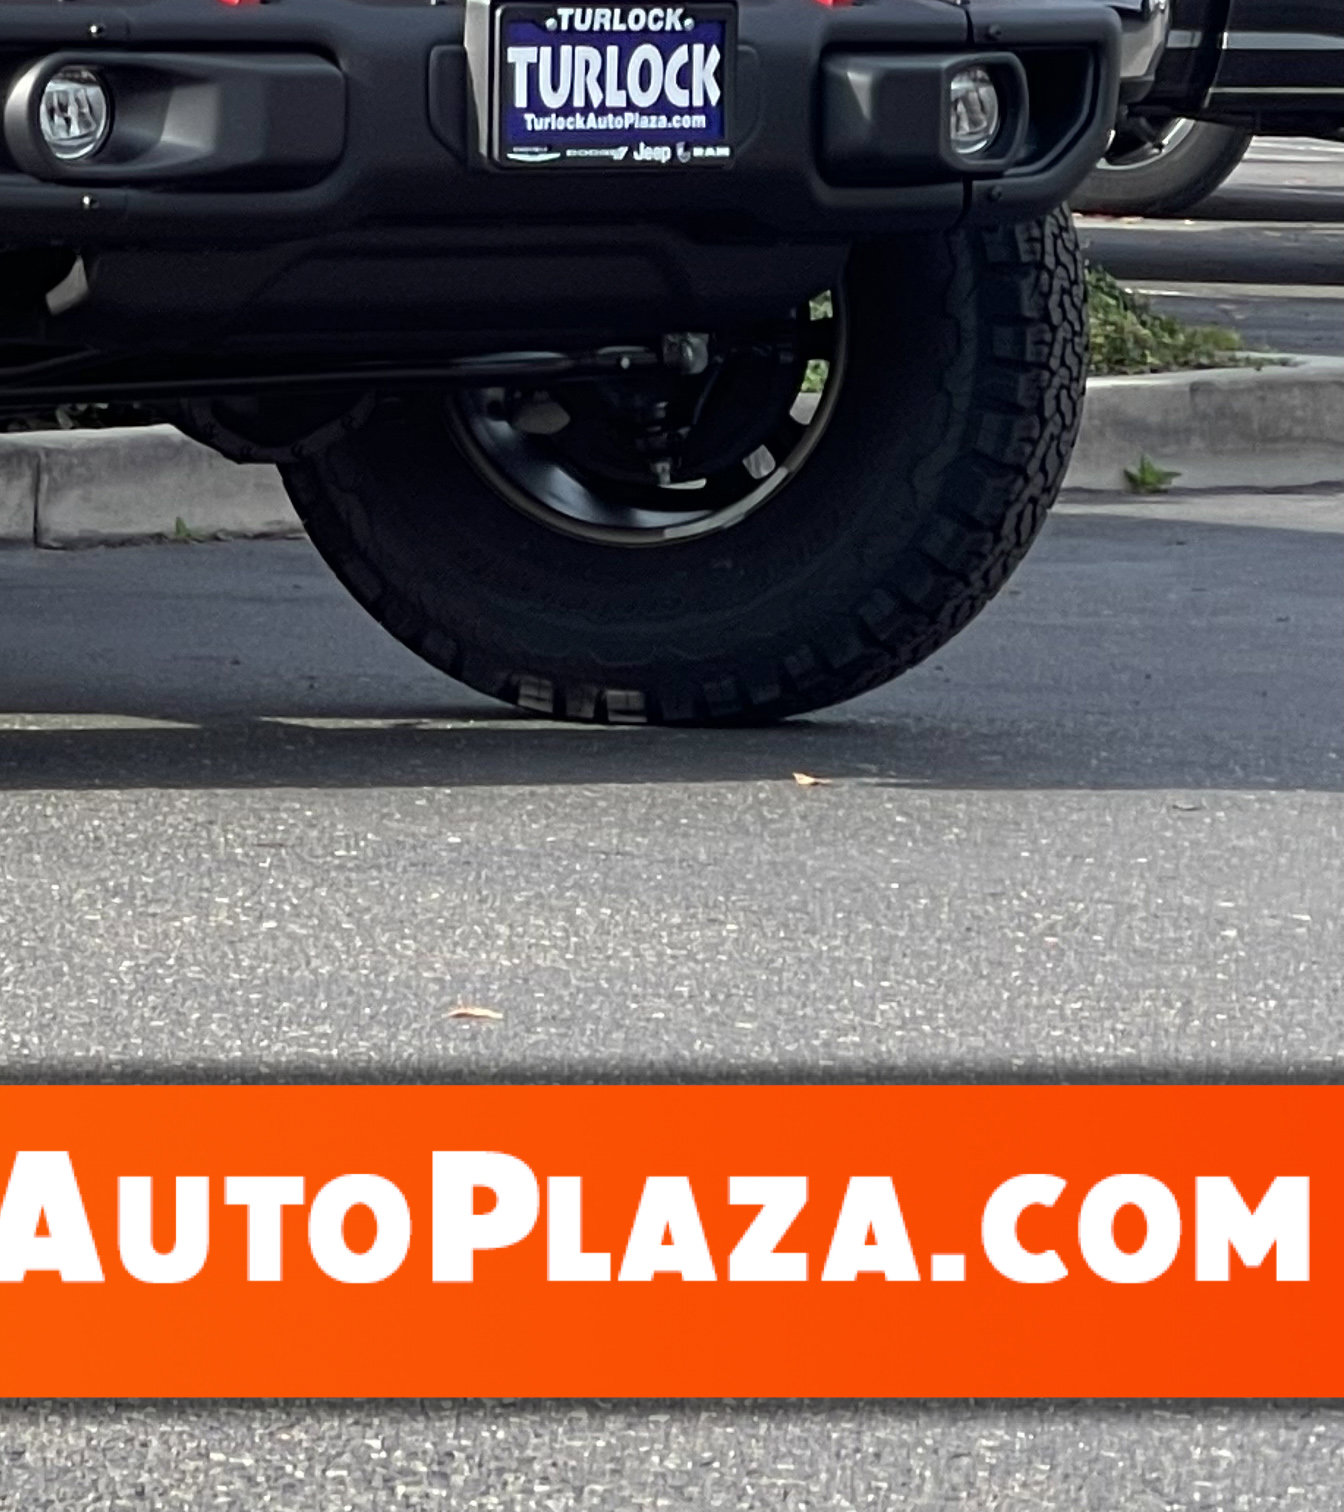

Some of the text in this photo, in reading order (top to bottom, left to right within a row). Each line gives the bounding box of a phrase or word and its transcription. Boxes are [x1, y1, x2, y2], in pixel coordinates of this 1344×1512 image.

[556, 7, 685, 32] TURLOCK
[506, 43, 721, 108] TURLOCK
[523, 112, 707, 131] TurlockAutoPlaza.com
[633, 141, 672, 164] Jeep
